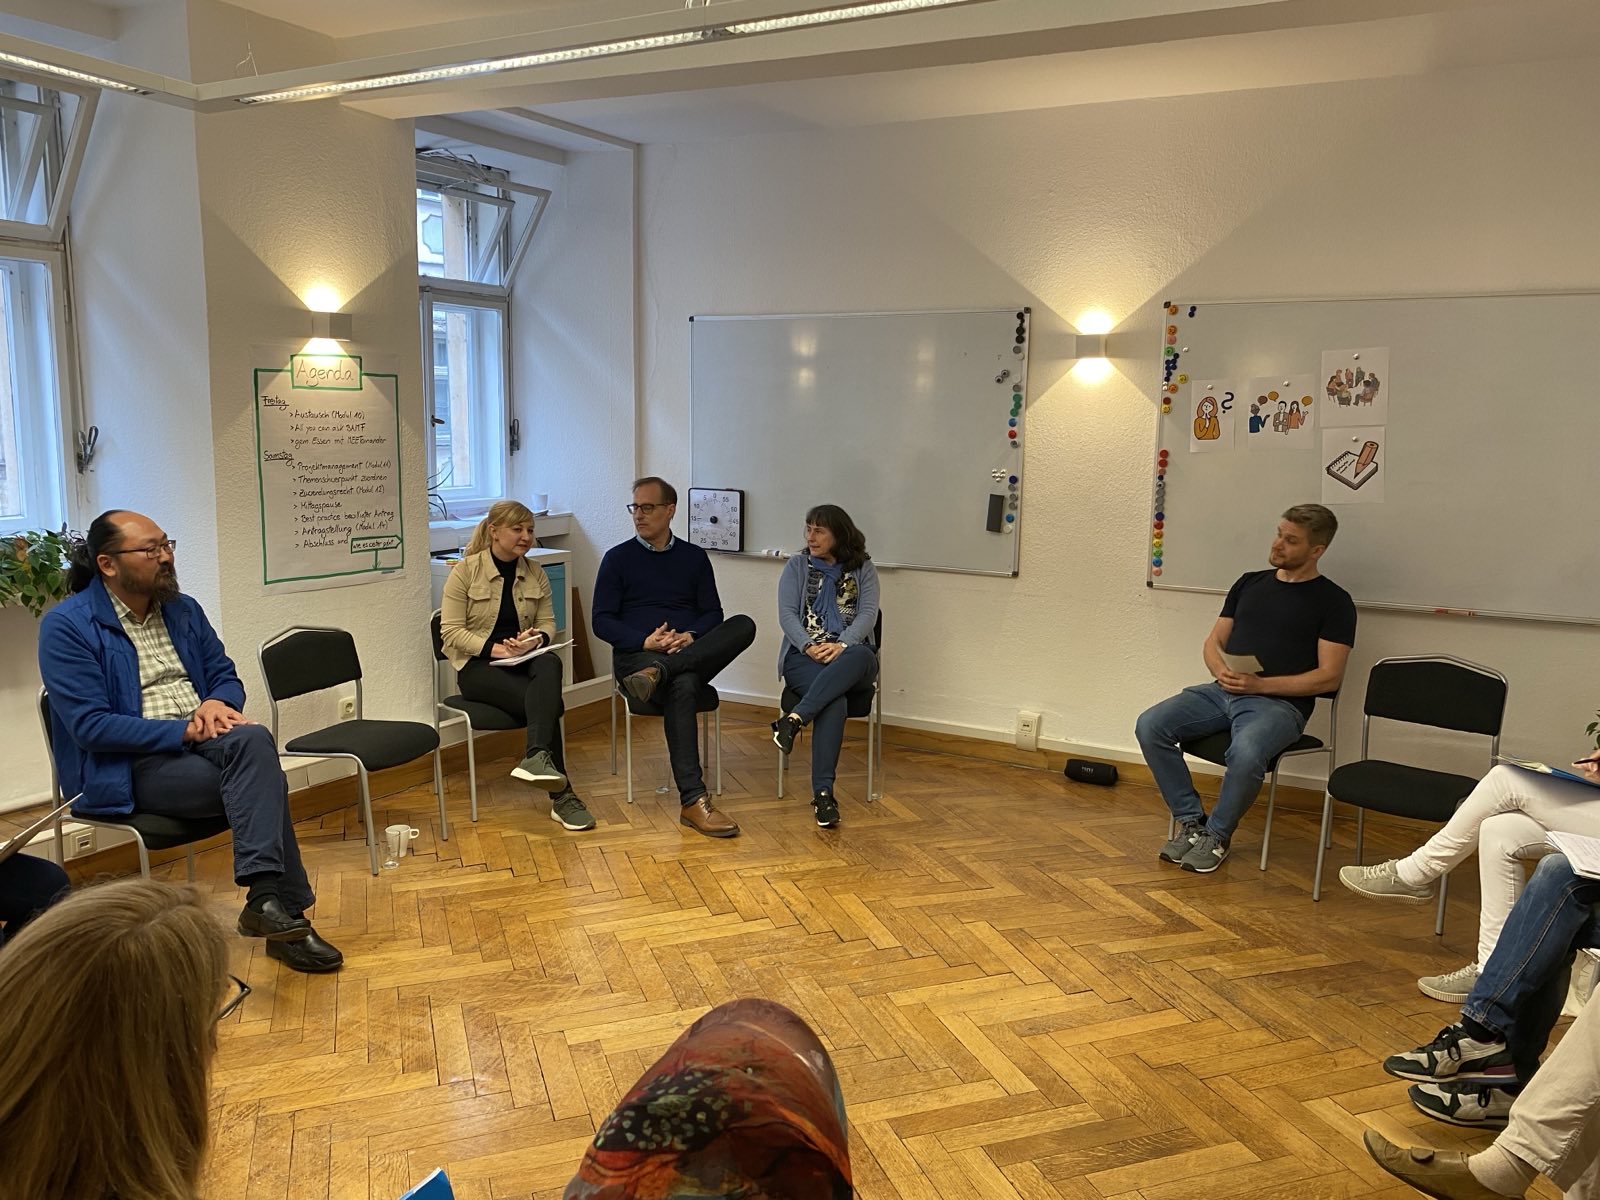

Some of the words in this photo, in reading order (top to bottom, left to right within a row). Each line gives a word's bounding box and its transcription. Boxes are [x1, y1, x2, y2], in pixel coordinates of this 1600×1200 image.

[296, 360, 354, 387] Agenda
[261, 395, 288, 411] Freitag
[294, 408, 330, 419] Austausch
[331, 410, 352, 420] (Modul
[306, 425, 316, 434] you
[332, 423, 344, 432] ask
[312, 436, 331, 445] Essen
[334, 437, 344, 445] mit
[263, 450, 294, 467] Samstag
[297, 461, 363, 475] Projektmanagement
[298, 474, 358, 487] Themenschwerpunkt
[360, 474, 388, 482] zuordnen
[299, 487, 354, 499] Zuwendungsrecht
[300, 501, 342, 513] Mittagspause
[301, 514, 315, 523] Best
[373, 509, 394, 520] Antrag
[302, 524, 353, 539] Antragstellung
[355, 522, 375, 532] (Modul
[303, 538, 334, 548] Abschluss
[337, 537, 349, 545] und
